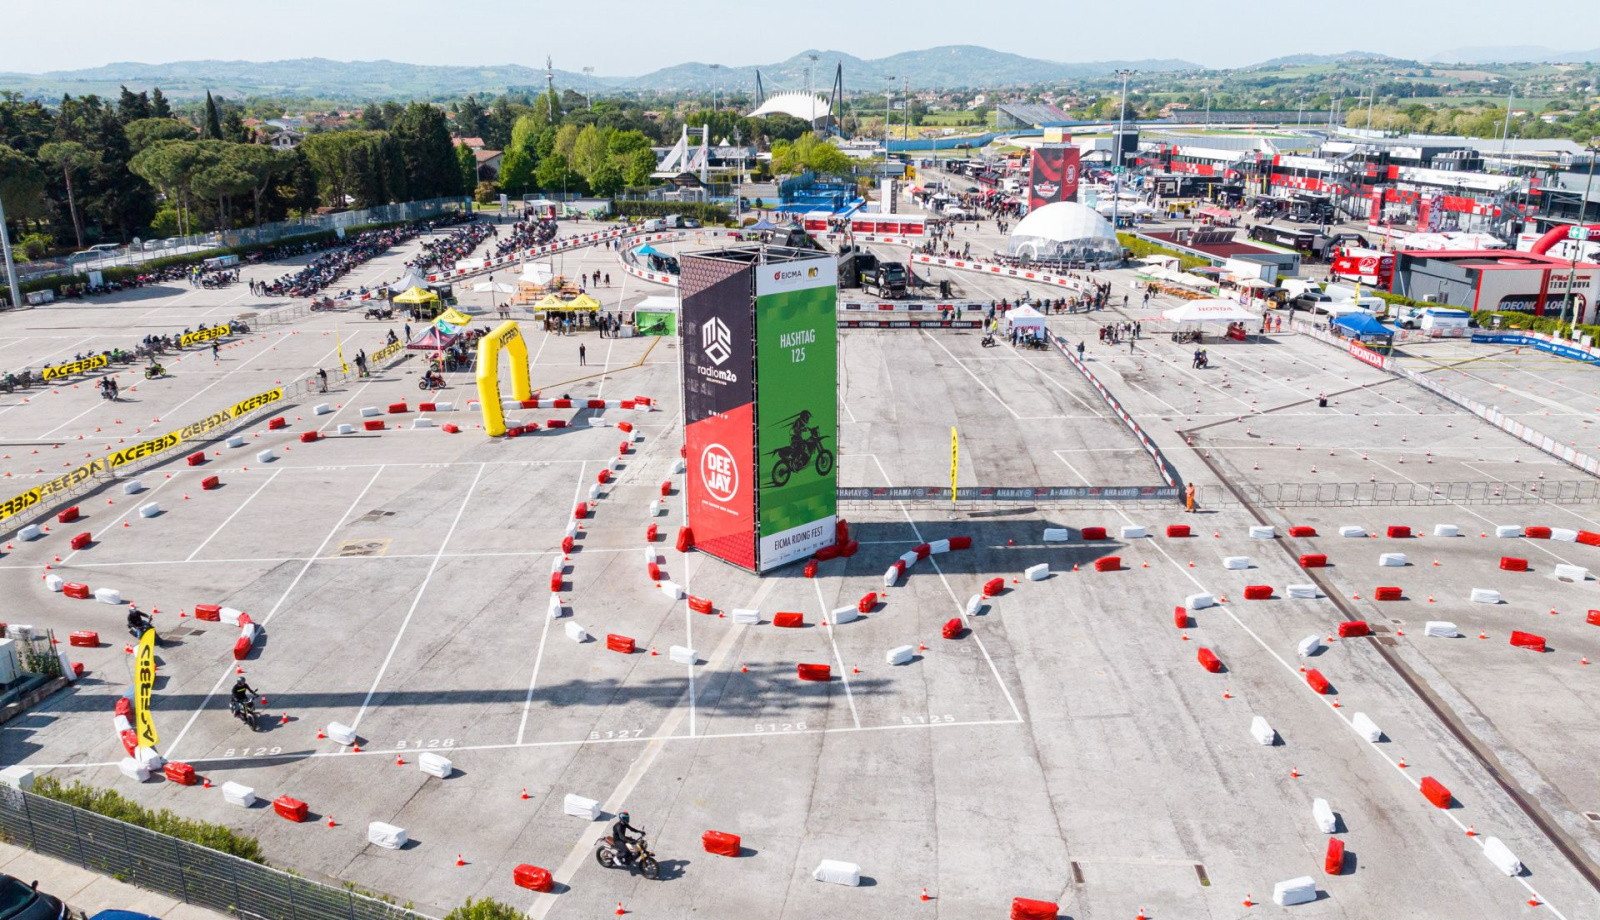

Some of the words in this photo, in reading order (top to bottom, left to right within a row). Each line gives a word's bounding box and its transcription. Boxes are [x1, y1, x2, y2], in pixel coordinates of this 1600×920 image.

[781, 270, 802, 280] EICMA
[780, 328, 816, 349] HASHTAG
[791, 347, 806, 363] 125
[1350, 344, 1382, 366] HONDA
[707, 452, 731, 476] DEE
[708, 471, 731, 493] JAY
[774, 537, 791, 551] EICMA
[791, 531, 811, 545] RIDING
[811, 525, 824, 538] FEST
[754, 722, 808, 732] B126
[902, 714, 956, 725] B125
[223, 746, 283, 757] B129
[395, 738, 456, 750] B128
